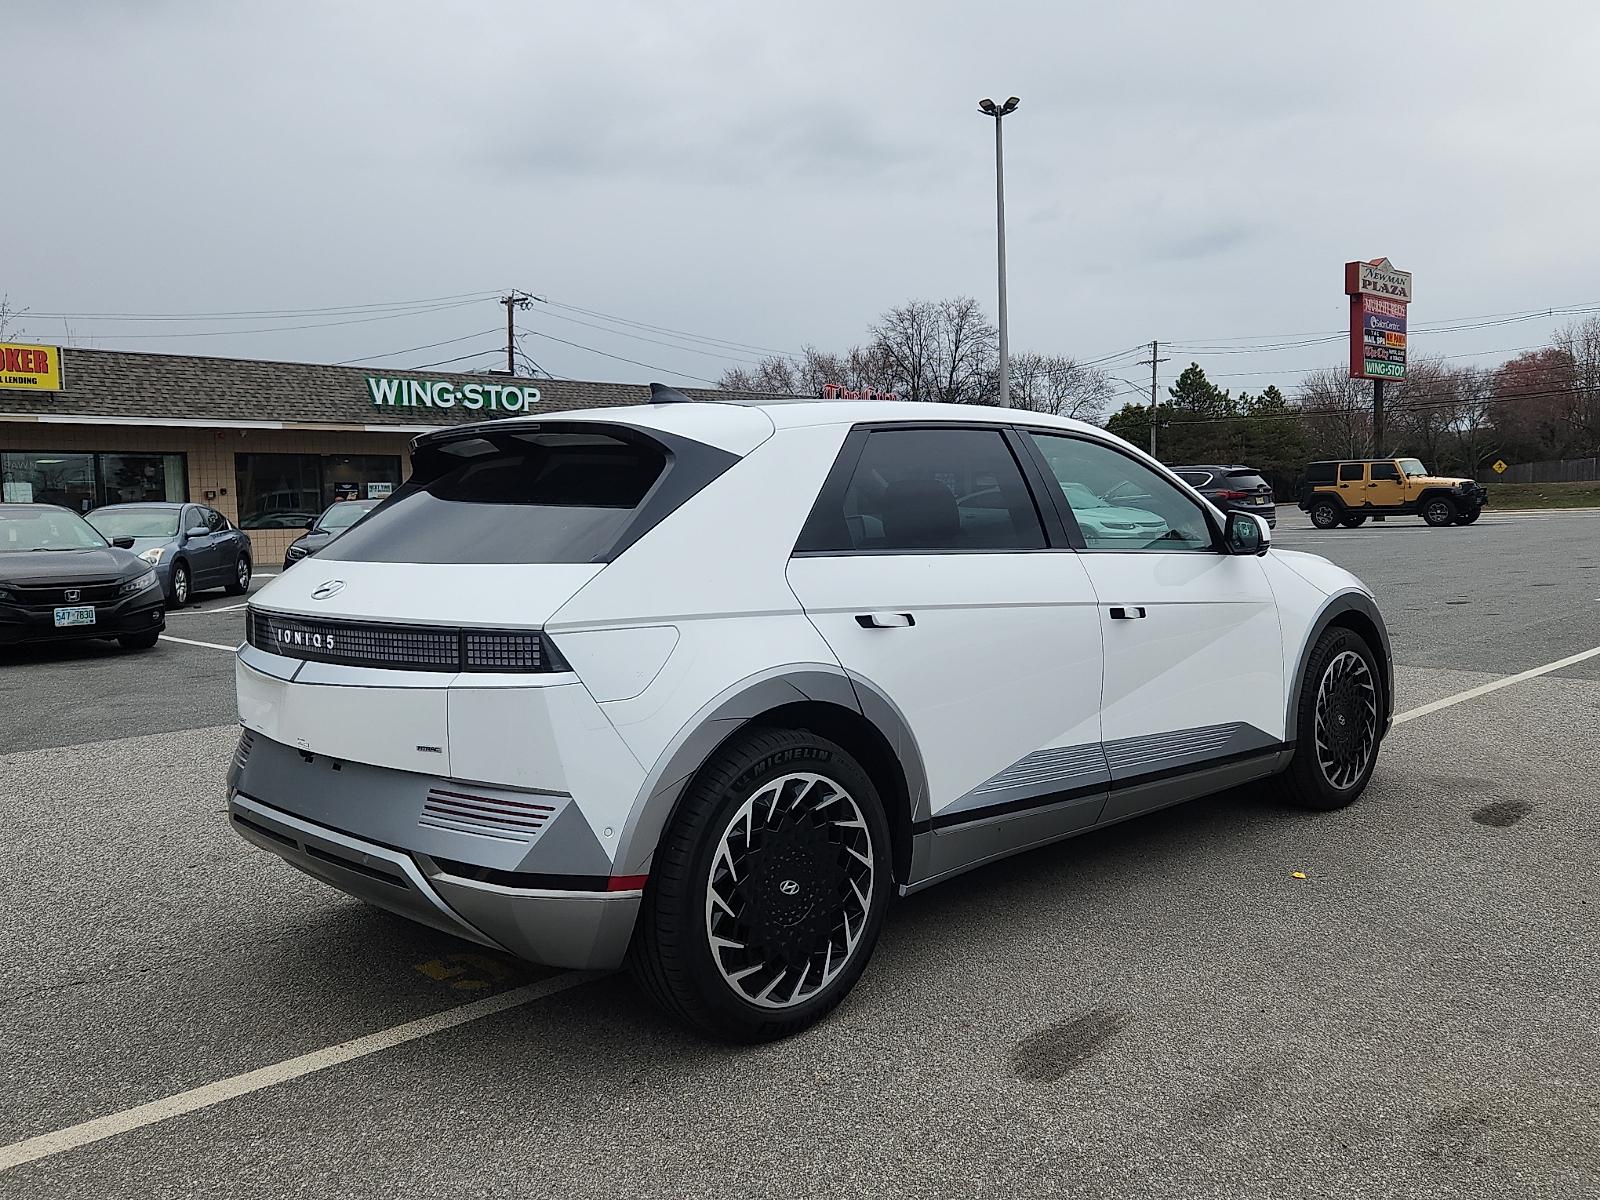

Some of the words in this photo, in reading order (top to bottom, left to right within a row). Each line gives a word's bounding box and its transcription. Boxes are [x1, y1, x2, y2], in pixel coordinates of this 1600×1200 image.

[1362, 279, 1408, 297] PLAZA
[1376, 337, 1385, 345] SPA
[5, 376, 37, 385] LENDING
[278, 629, 321, 647] IONIQ
[326, 635, 334, 649] 5
[753, 749, 829, 776] MICHELIN
